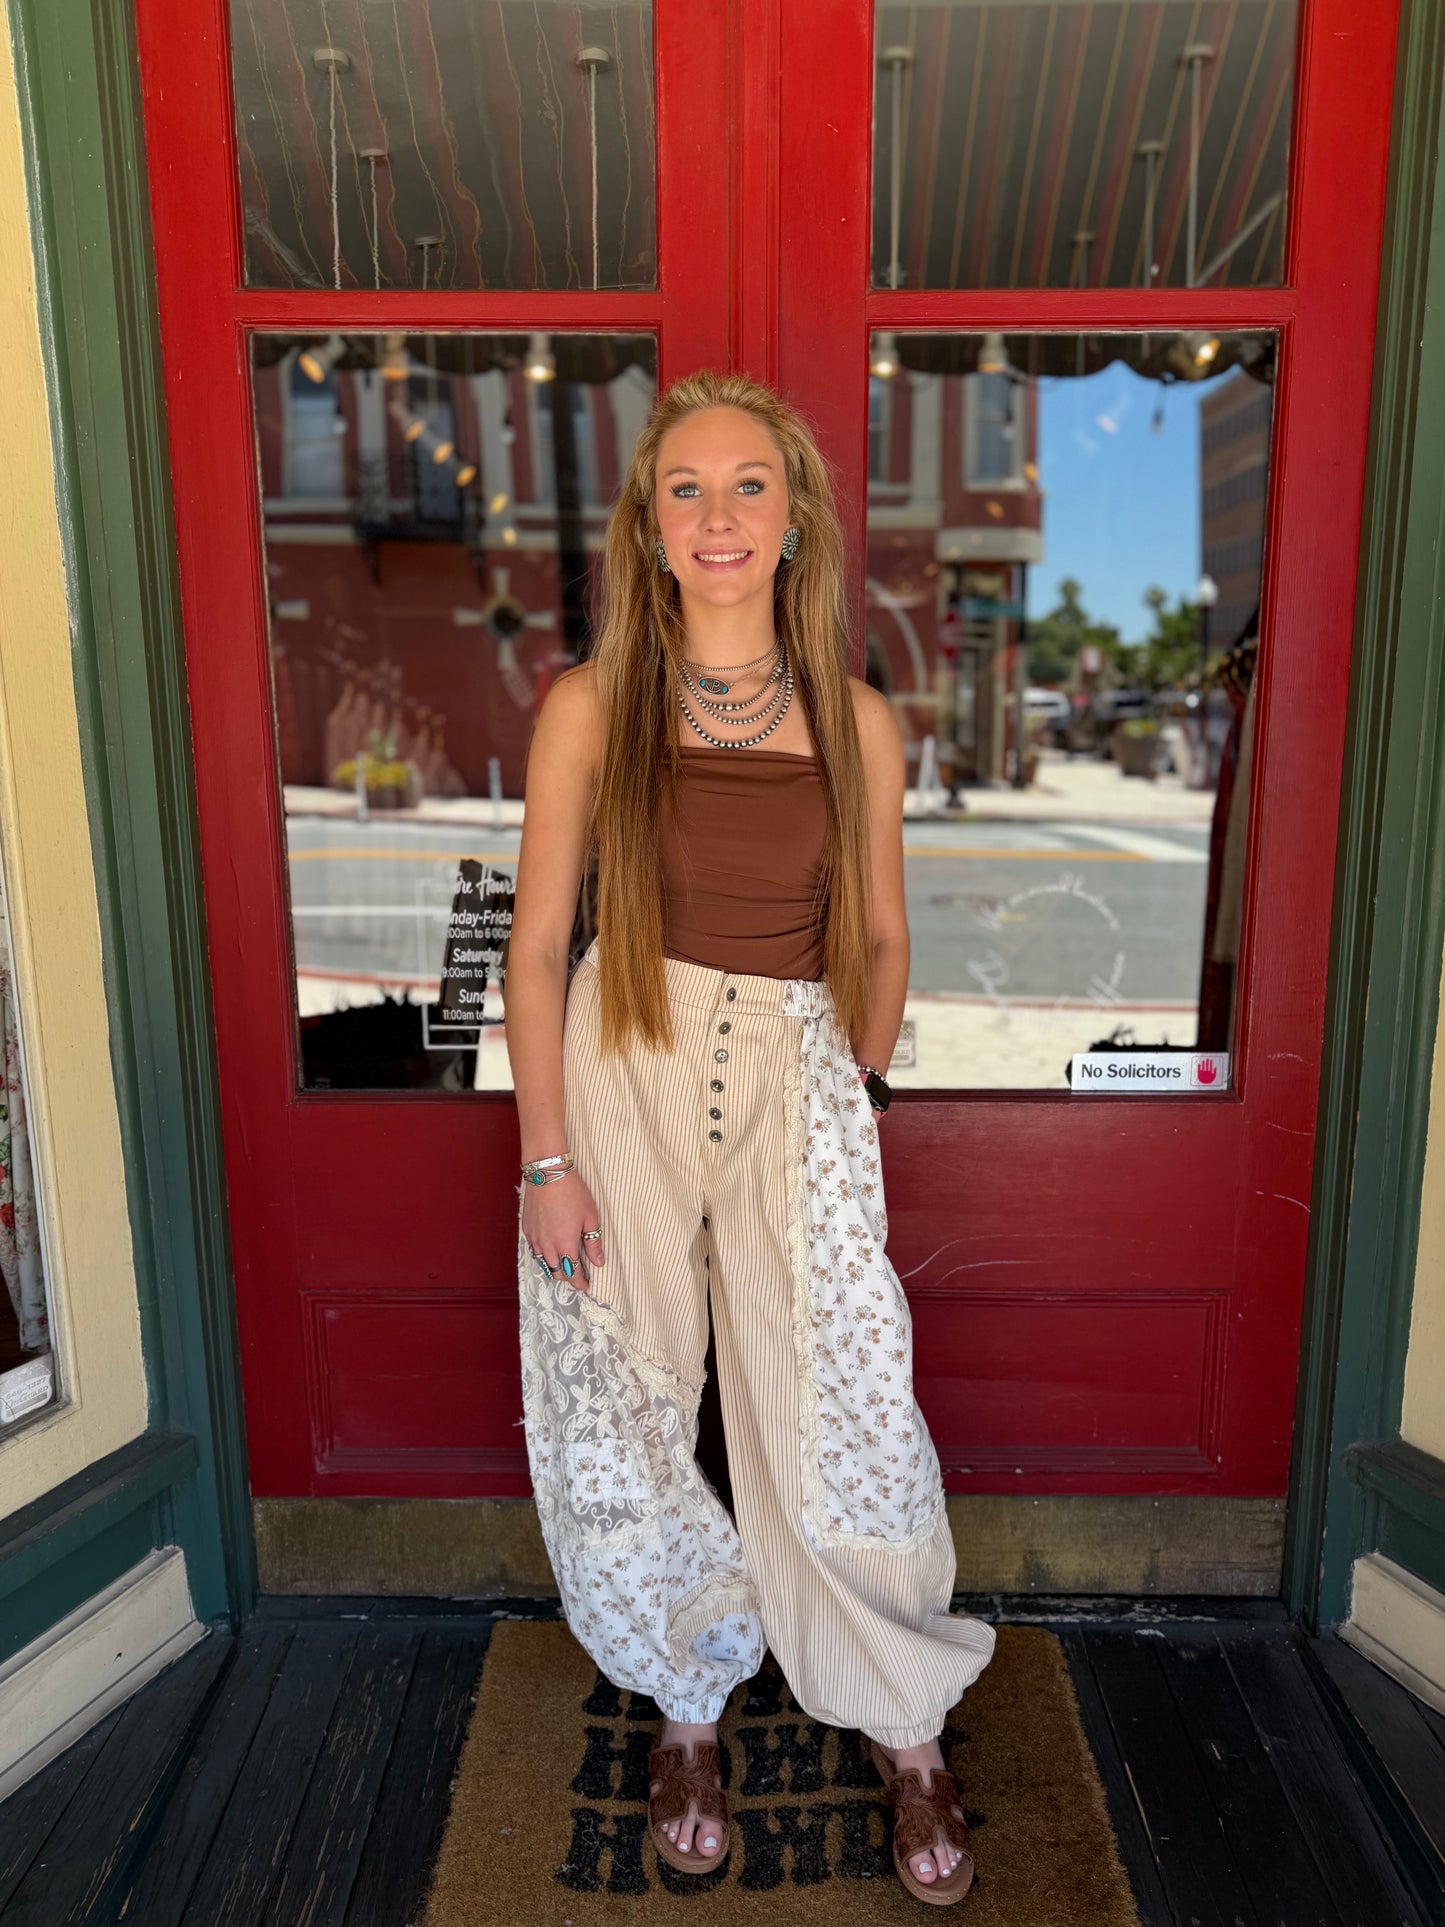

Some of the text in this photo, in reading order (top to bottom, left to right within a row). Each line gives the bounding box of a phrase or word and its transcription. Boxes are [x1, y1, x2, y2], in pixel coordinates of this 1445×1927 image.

[451, 909, 513, 928] nday-Frida
[474, 928, 484, 939] to
[452, 947, 504, 966] Saturday
[474, 967, 484, 978] to
[442, 1009, 475, 1021] 11:00am
[1081, 1064, 1182, 1079] No Solicitors
